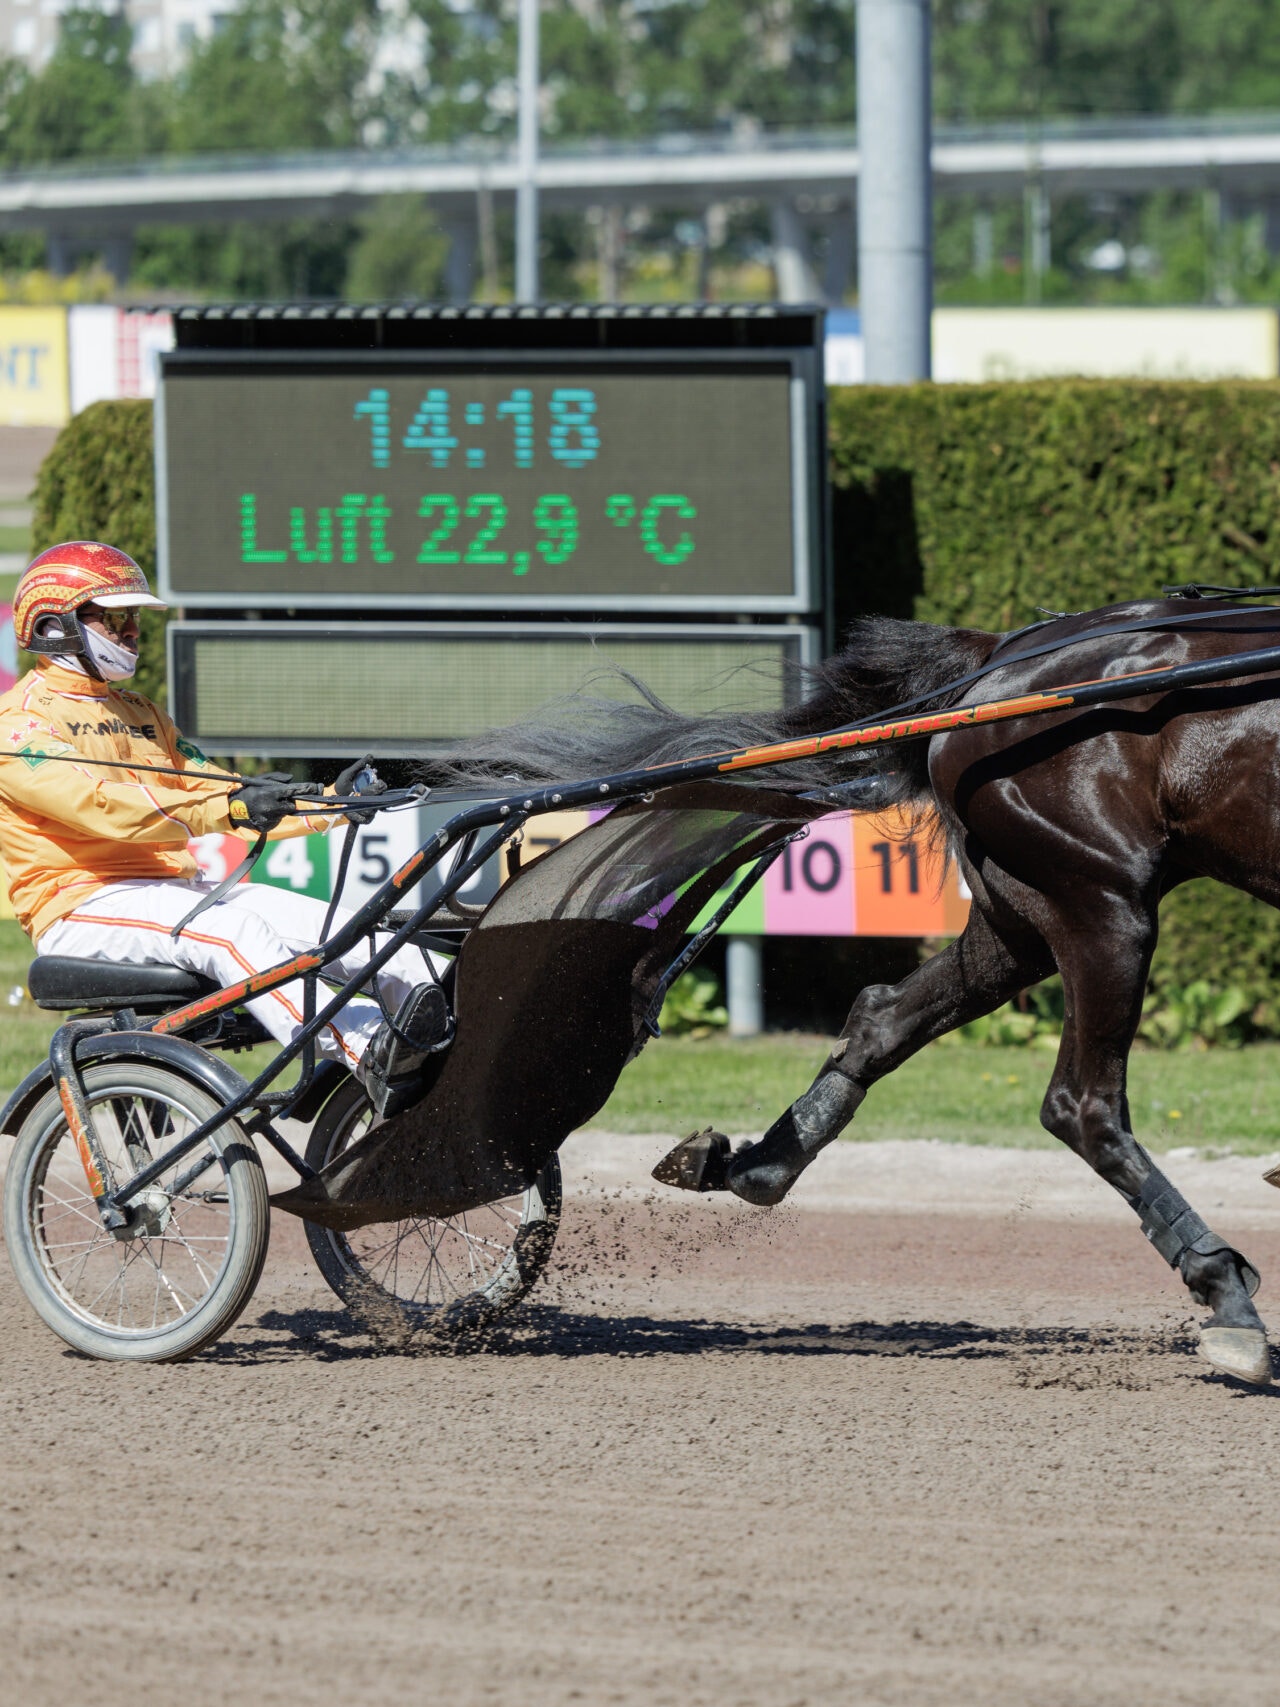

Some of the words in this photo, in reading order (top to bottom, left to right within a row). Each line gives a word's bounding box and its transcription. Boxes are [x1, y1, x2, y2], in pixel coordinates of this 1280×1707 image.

[353, 388, 600, 468] 14:18
[240, 493, 394, 563] Luft
[416, 493, 578, 575] 22,9
[820, 710, 973, 750] FINNTACK
[266, 838, 313, 888] 4
[360, 836, 390, 884] 5
[780, 841, 842, 893] 10
[871, 841, 920, 894] 11
